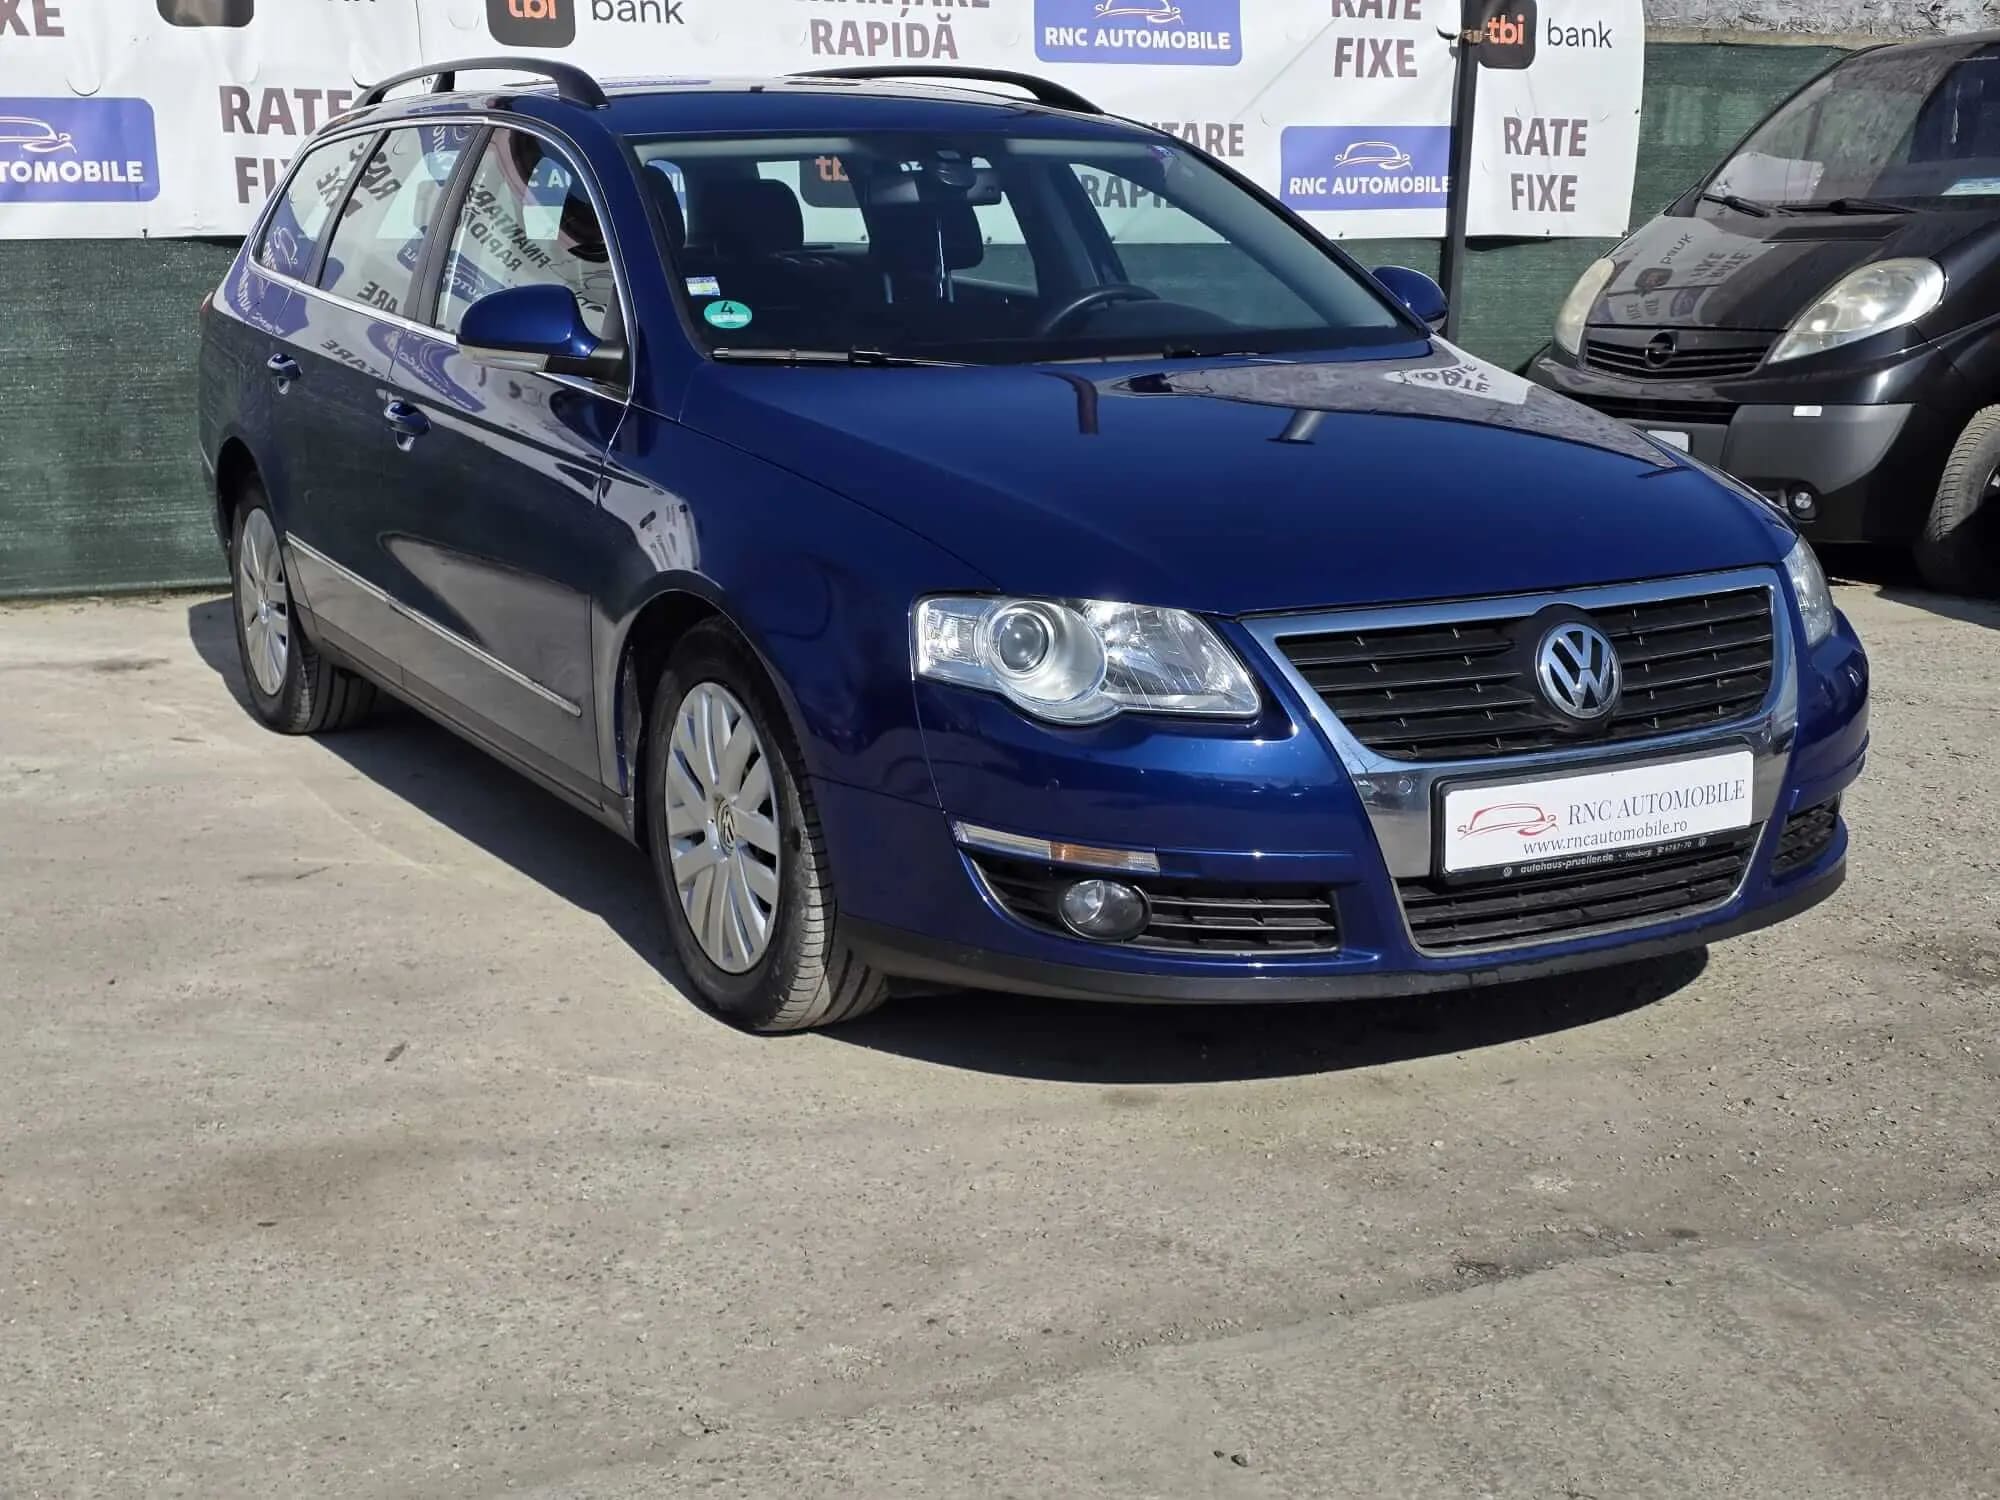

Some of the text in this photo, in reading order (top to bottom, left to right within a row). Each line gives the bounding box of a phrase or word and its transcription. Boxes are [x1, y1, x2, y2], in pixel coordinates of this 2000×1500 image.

[592, 0, 685, 24] bank
[1045, 27, 1232, 50] RNC AUTOMOBILE
[1487, 15, 1525, 45] tbi
[1547, 18, 1613, 49] bank
[1333, 37, 1418, 78] FIXE
[1503, 116, 1589, 157] RATE
[1289, 175, 1452, 195] RNC AUTOMOBILE
[1510, 173, 1578, 213] FIXE
[721, 302, 735, 314] 4
[1568, 779, 1745, 825] RNC AUTOMOBILE
[1523, 820, 1688, 854] www.rncautomobile.ro
